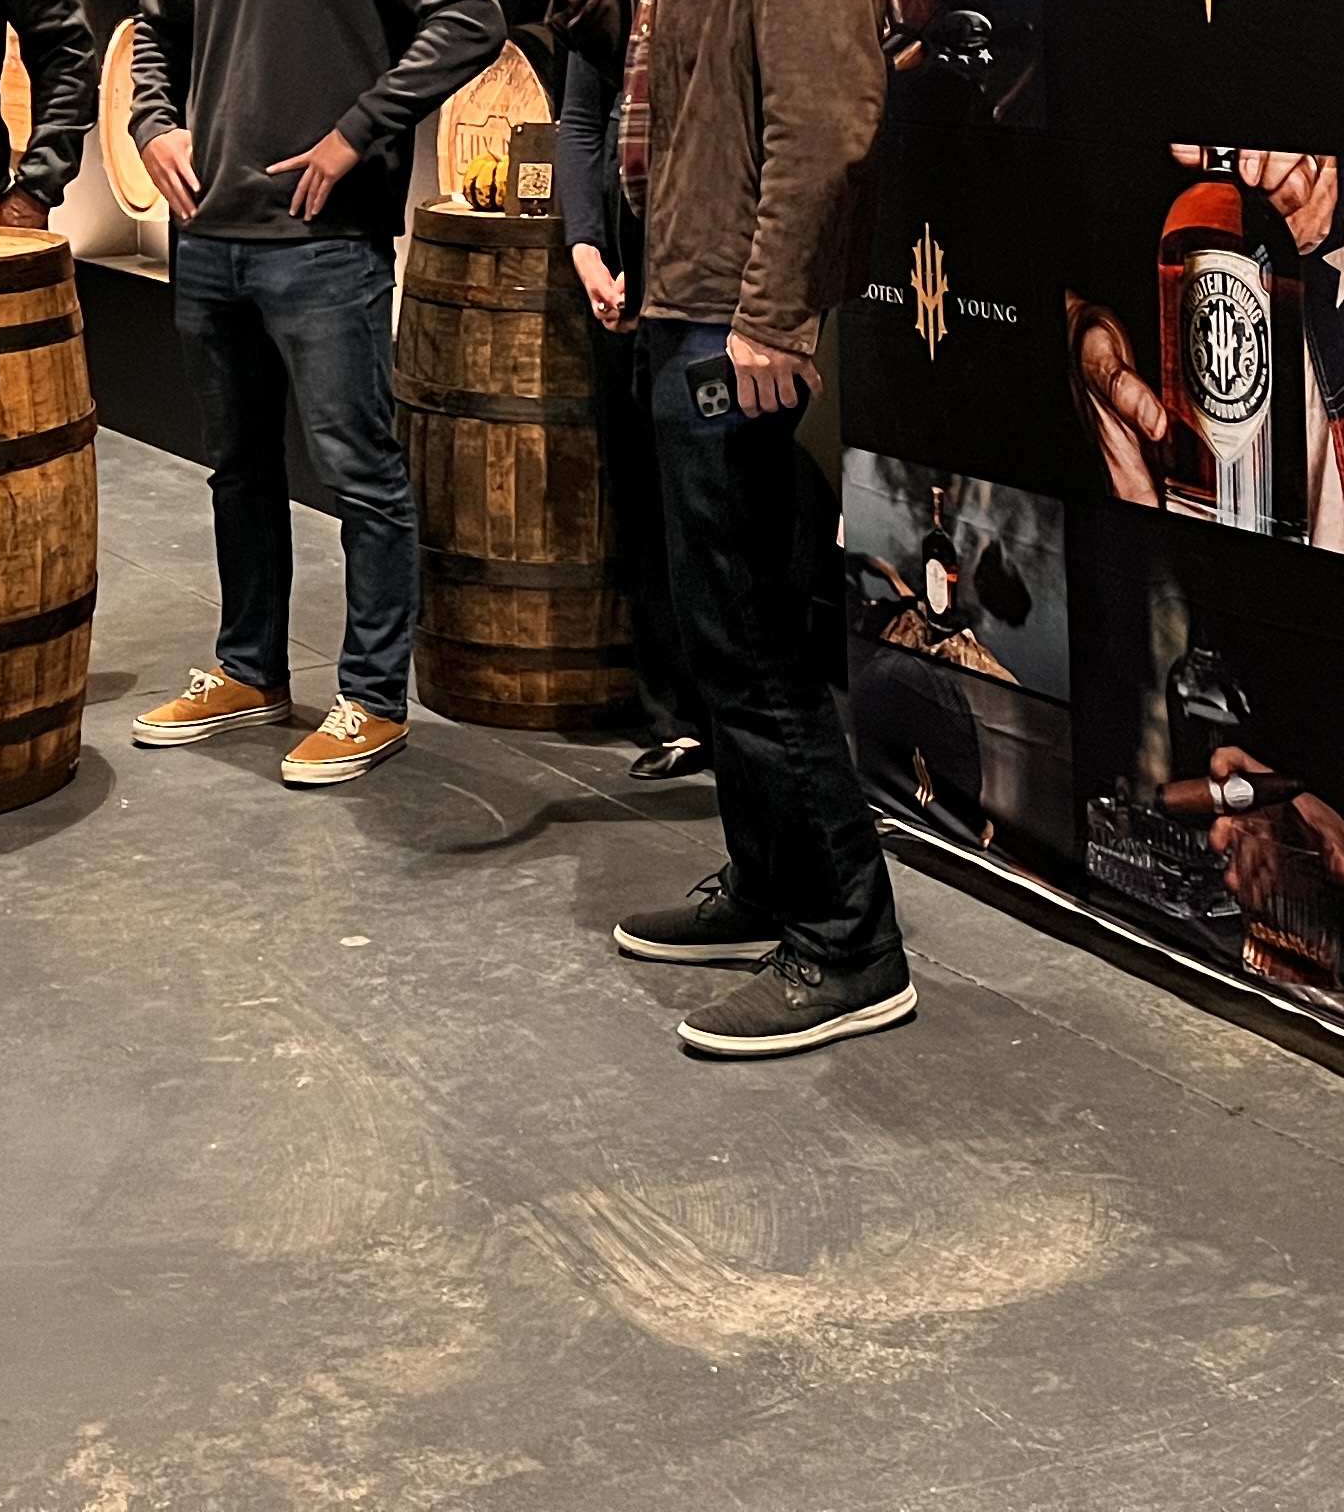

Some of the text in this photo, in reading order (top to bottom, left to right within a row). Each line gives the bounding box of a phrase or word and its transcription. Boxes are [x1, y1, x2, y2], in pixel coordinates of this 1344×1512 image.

[860, 283, 1017, 323] OTEN YOUNG
[1226, 274, 1263, 324] YOUNG
